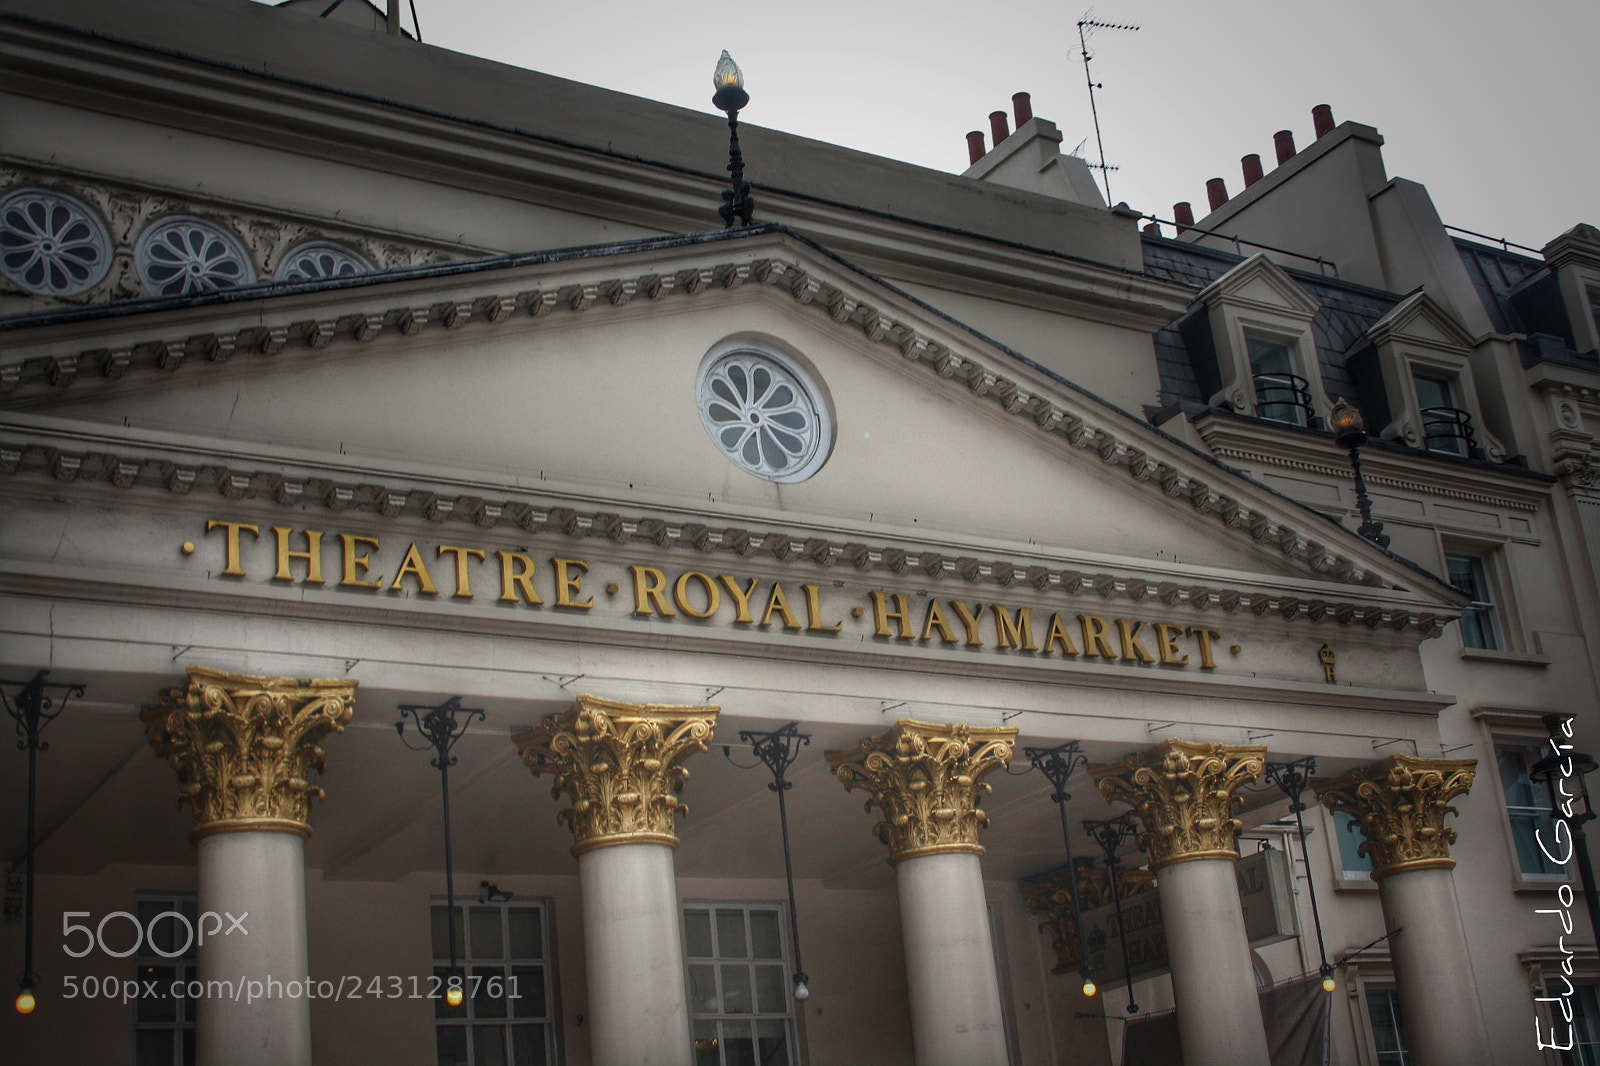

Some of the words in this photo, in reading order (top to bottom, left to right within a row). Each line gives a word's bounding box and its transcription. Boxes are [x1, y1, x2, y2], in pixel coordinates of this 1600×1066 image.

[206, 519, 594, 610] THEATRE
[629, 564, 842, 633] ROYAL
[870, 591, 1221, 669] HAYMARKET
